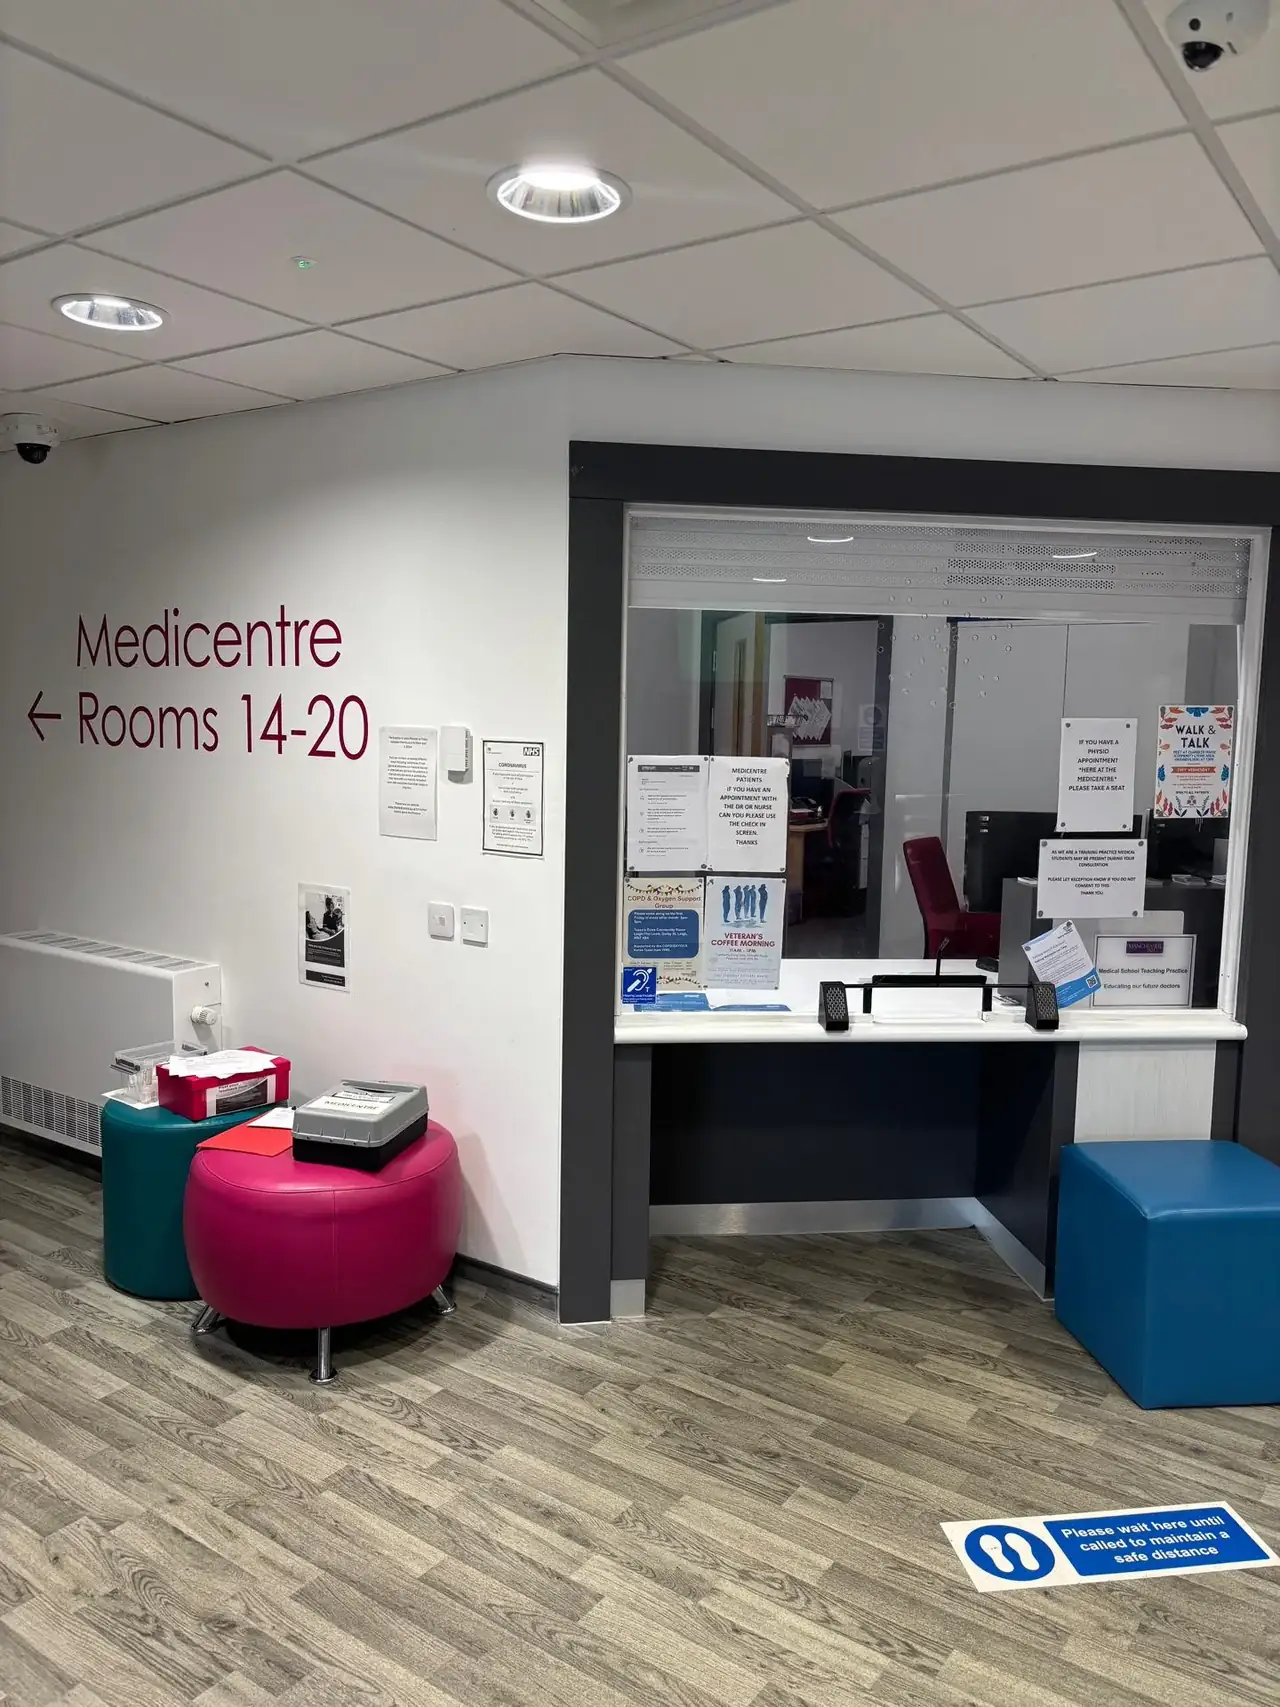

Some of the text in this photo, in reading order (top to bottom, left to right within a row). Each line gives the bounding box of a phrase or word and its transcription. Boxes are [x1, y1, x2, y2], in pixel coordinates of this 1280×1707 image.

[77, 604, 342, 668] Medicentre
[79, 691, 369, 761] Rooms 14-20
[1175, 725, 1216, 735] WALK &
[1181, 737, 1210, 748] TALK
[523, 747, 540, 756] NHS
[653, 895, 677, 903] Oxygen
[677, 895, 701, 903] Support
[724, 932, 763, 940] VETERAN'S
[1060, 1514, 1225, 1540] Please wait here until
[1079, 1530, 1230, 1553] called to maintain a
[1113, 1545, 1219, 1565] safe distance
